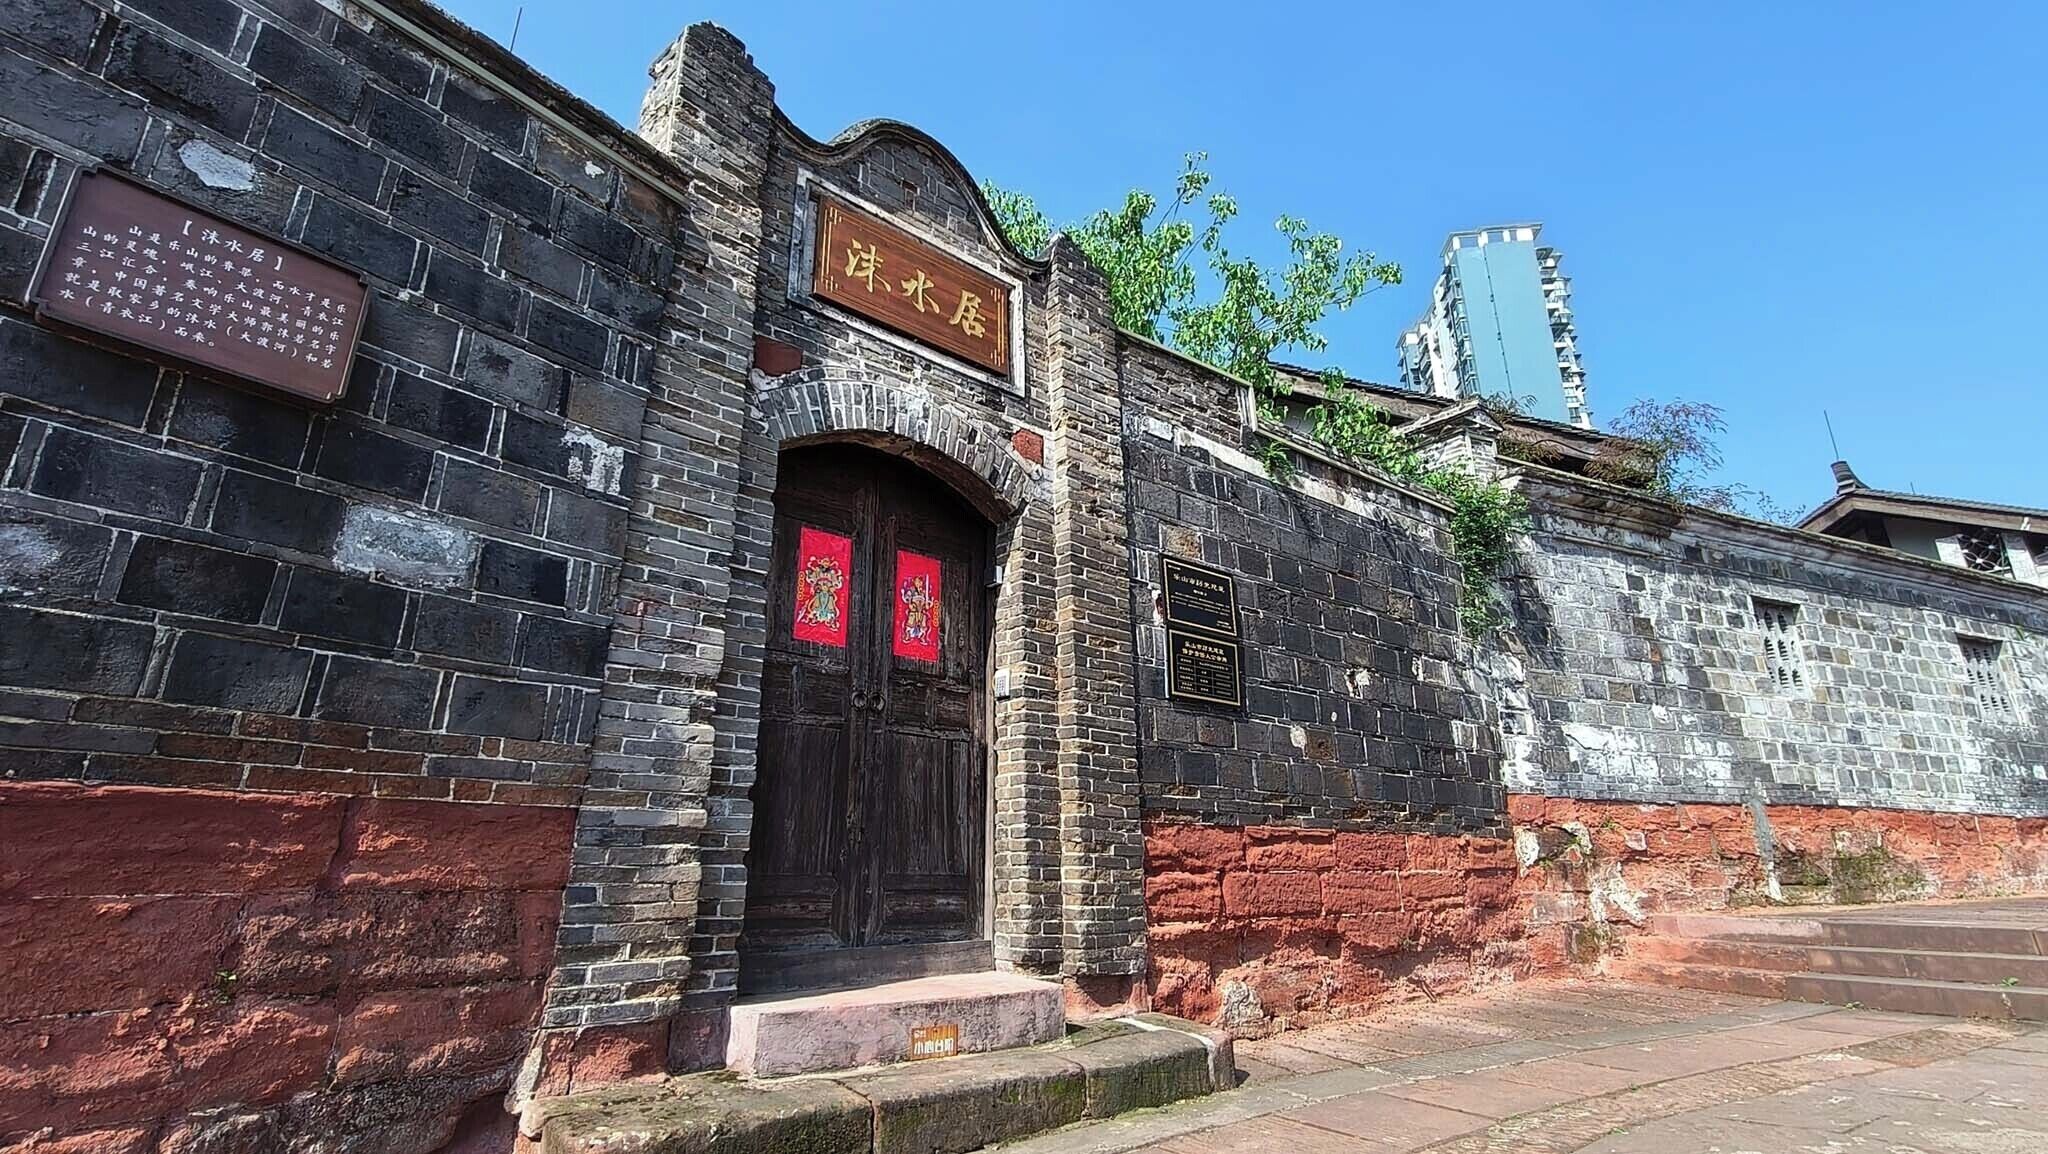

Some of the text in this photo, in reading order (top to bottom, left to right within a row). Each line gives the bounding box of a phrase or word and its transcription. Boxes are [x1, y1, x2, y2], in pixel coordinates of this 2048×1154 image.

[845, 238, 986, 338] 沫水居
[914, 1038, 954, 1056] 小心台阶
